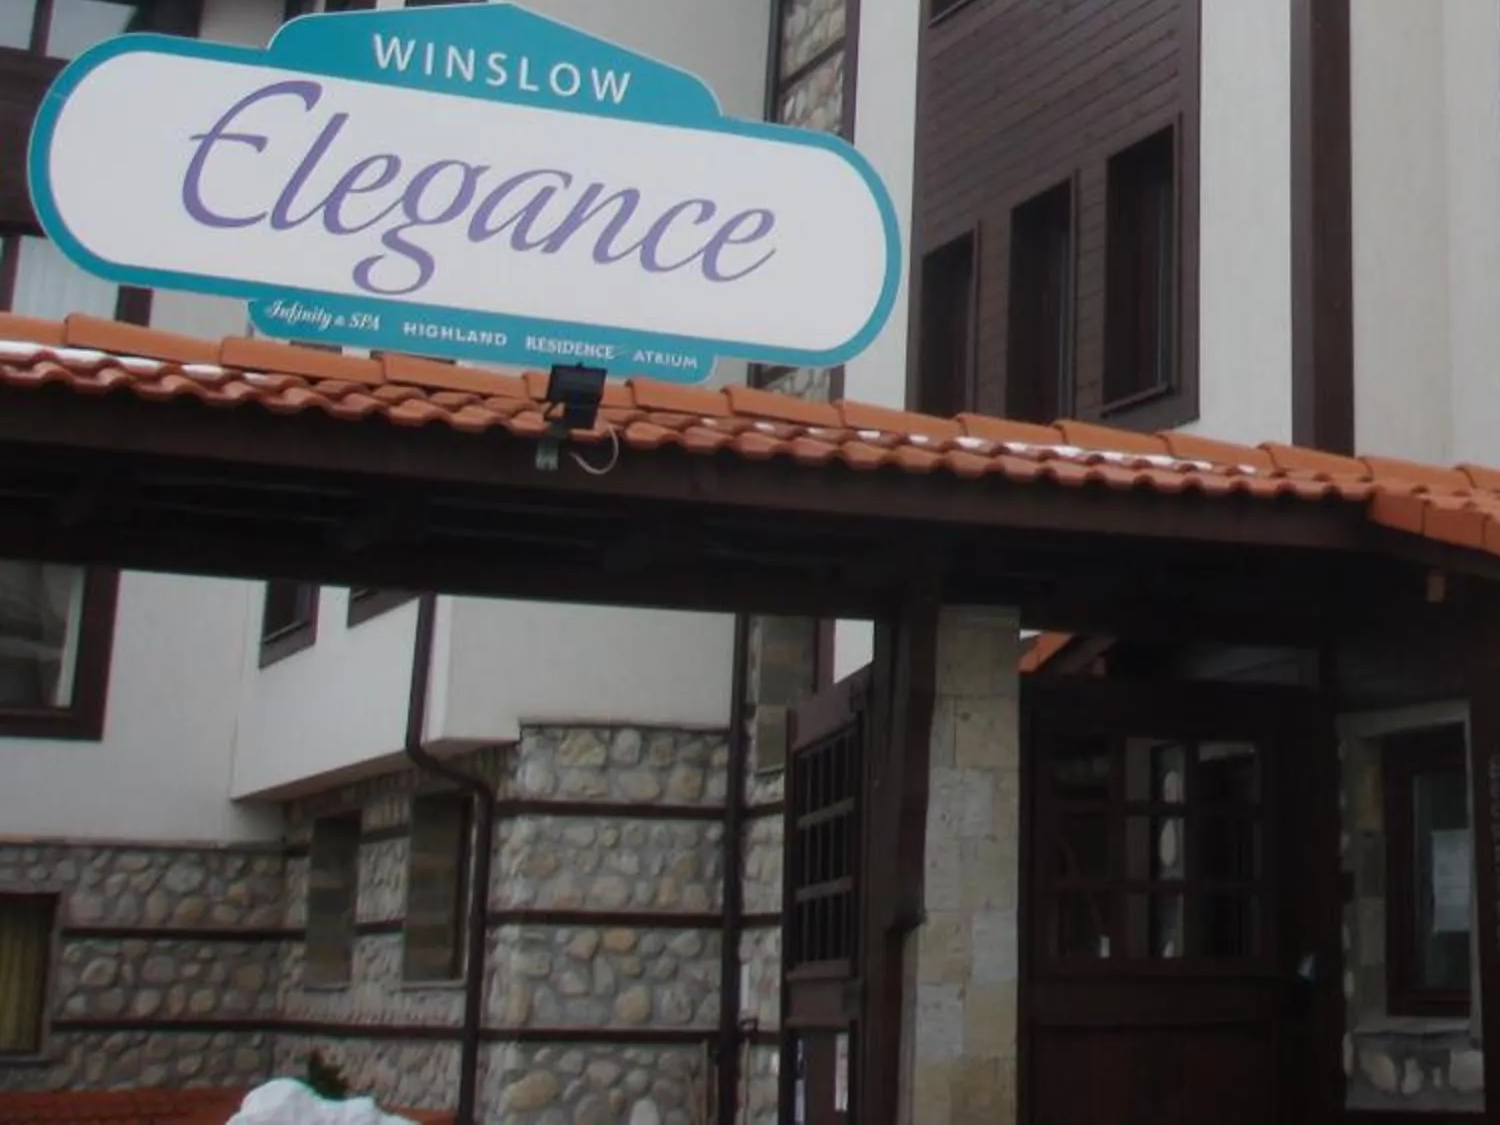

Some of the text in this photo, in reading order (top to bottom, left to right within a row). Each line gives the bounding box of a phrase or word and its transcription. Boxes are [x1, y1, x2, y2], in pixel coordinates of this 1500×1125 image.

[373, 32, 631, 105] WINSLOW
[181, 79, 777, 295] Elegance
[348, 312, 381, 332] SPA
[403, 321, 508, 347] HIGHLAND
[525, 335, 615, 360] RESIDENCE
[633, 349, 699, 370] ATRIUM
